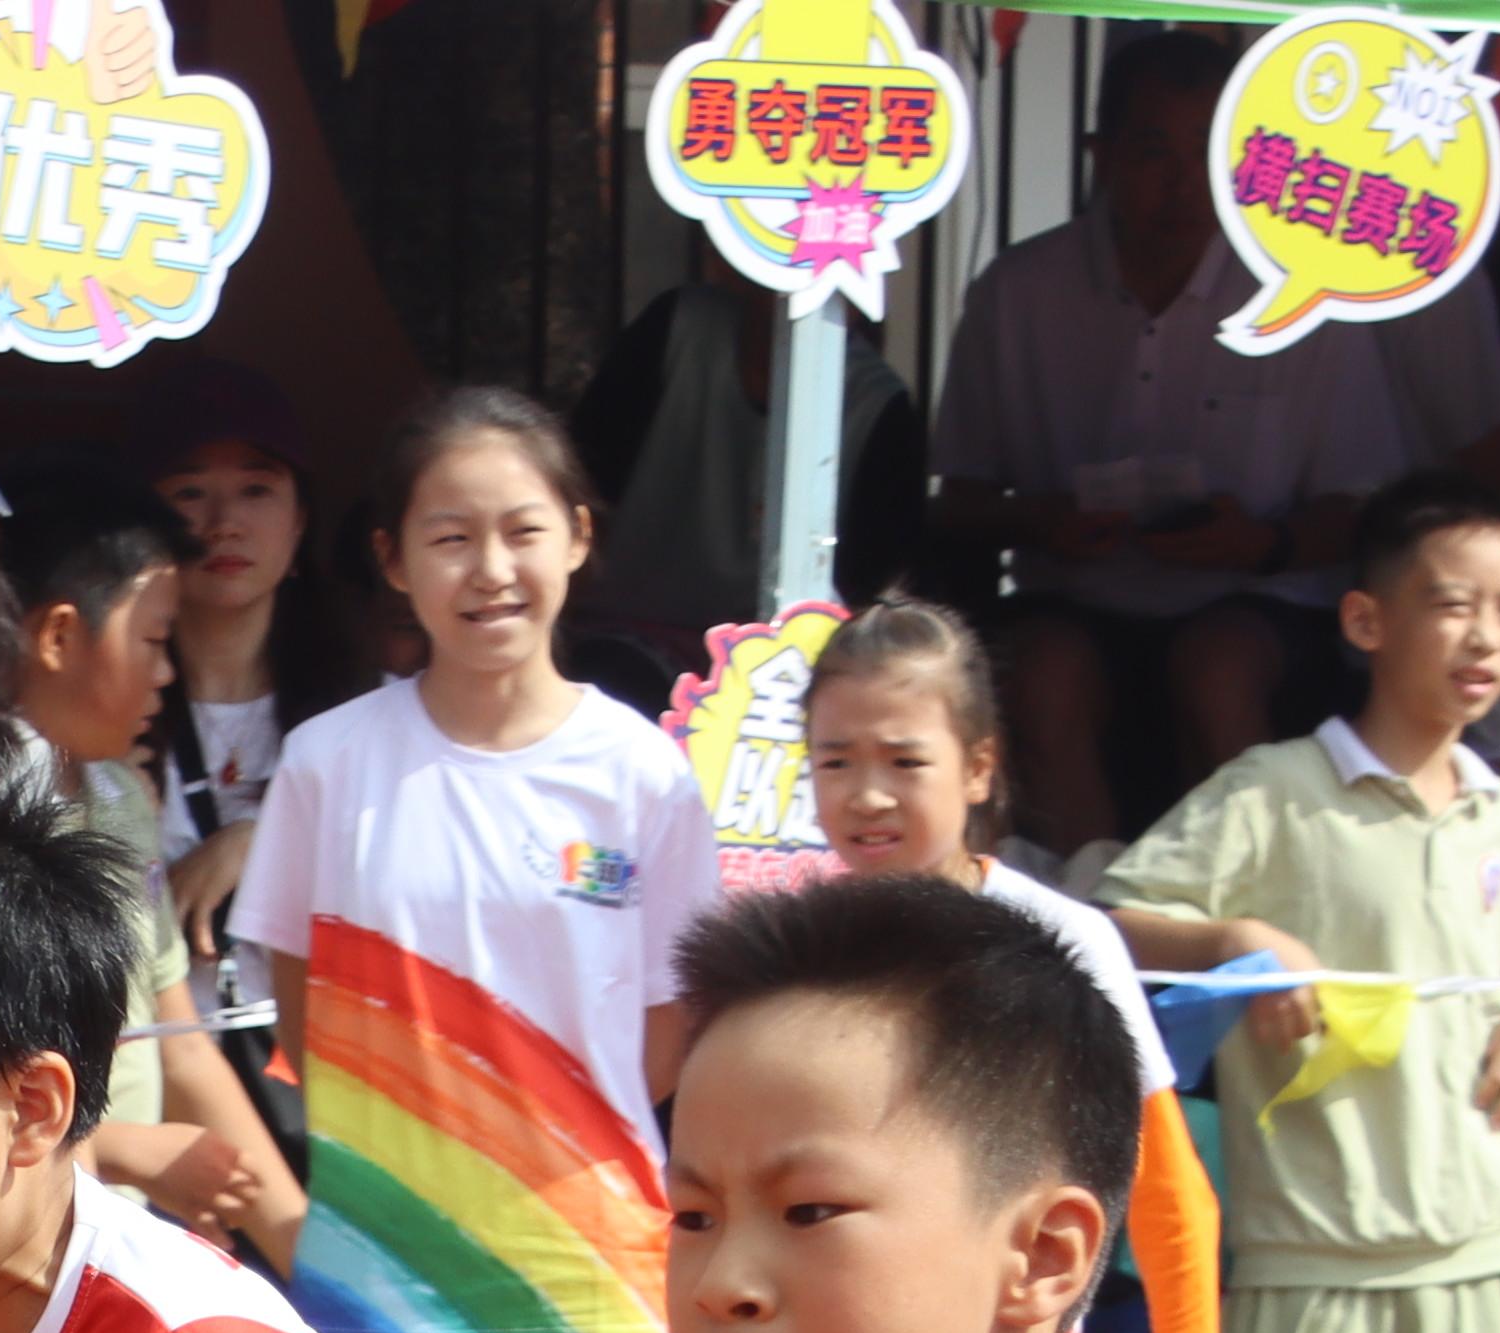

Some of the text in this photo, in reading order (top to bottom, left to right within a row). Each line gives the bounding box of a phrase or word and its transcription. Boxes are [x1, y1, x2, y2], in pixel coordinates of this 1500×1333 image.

[680, 78, 937, 170] 勇夺冠军
[799, 202, 872, 244] 加油
[1234, 126, 1460, 277] 横扫赛场
